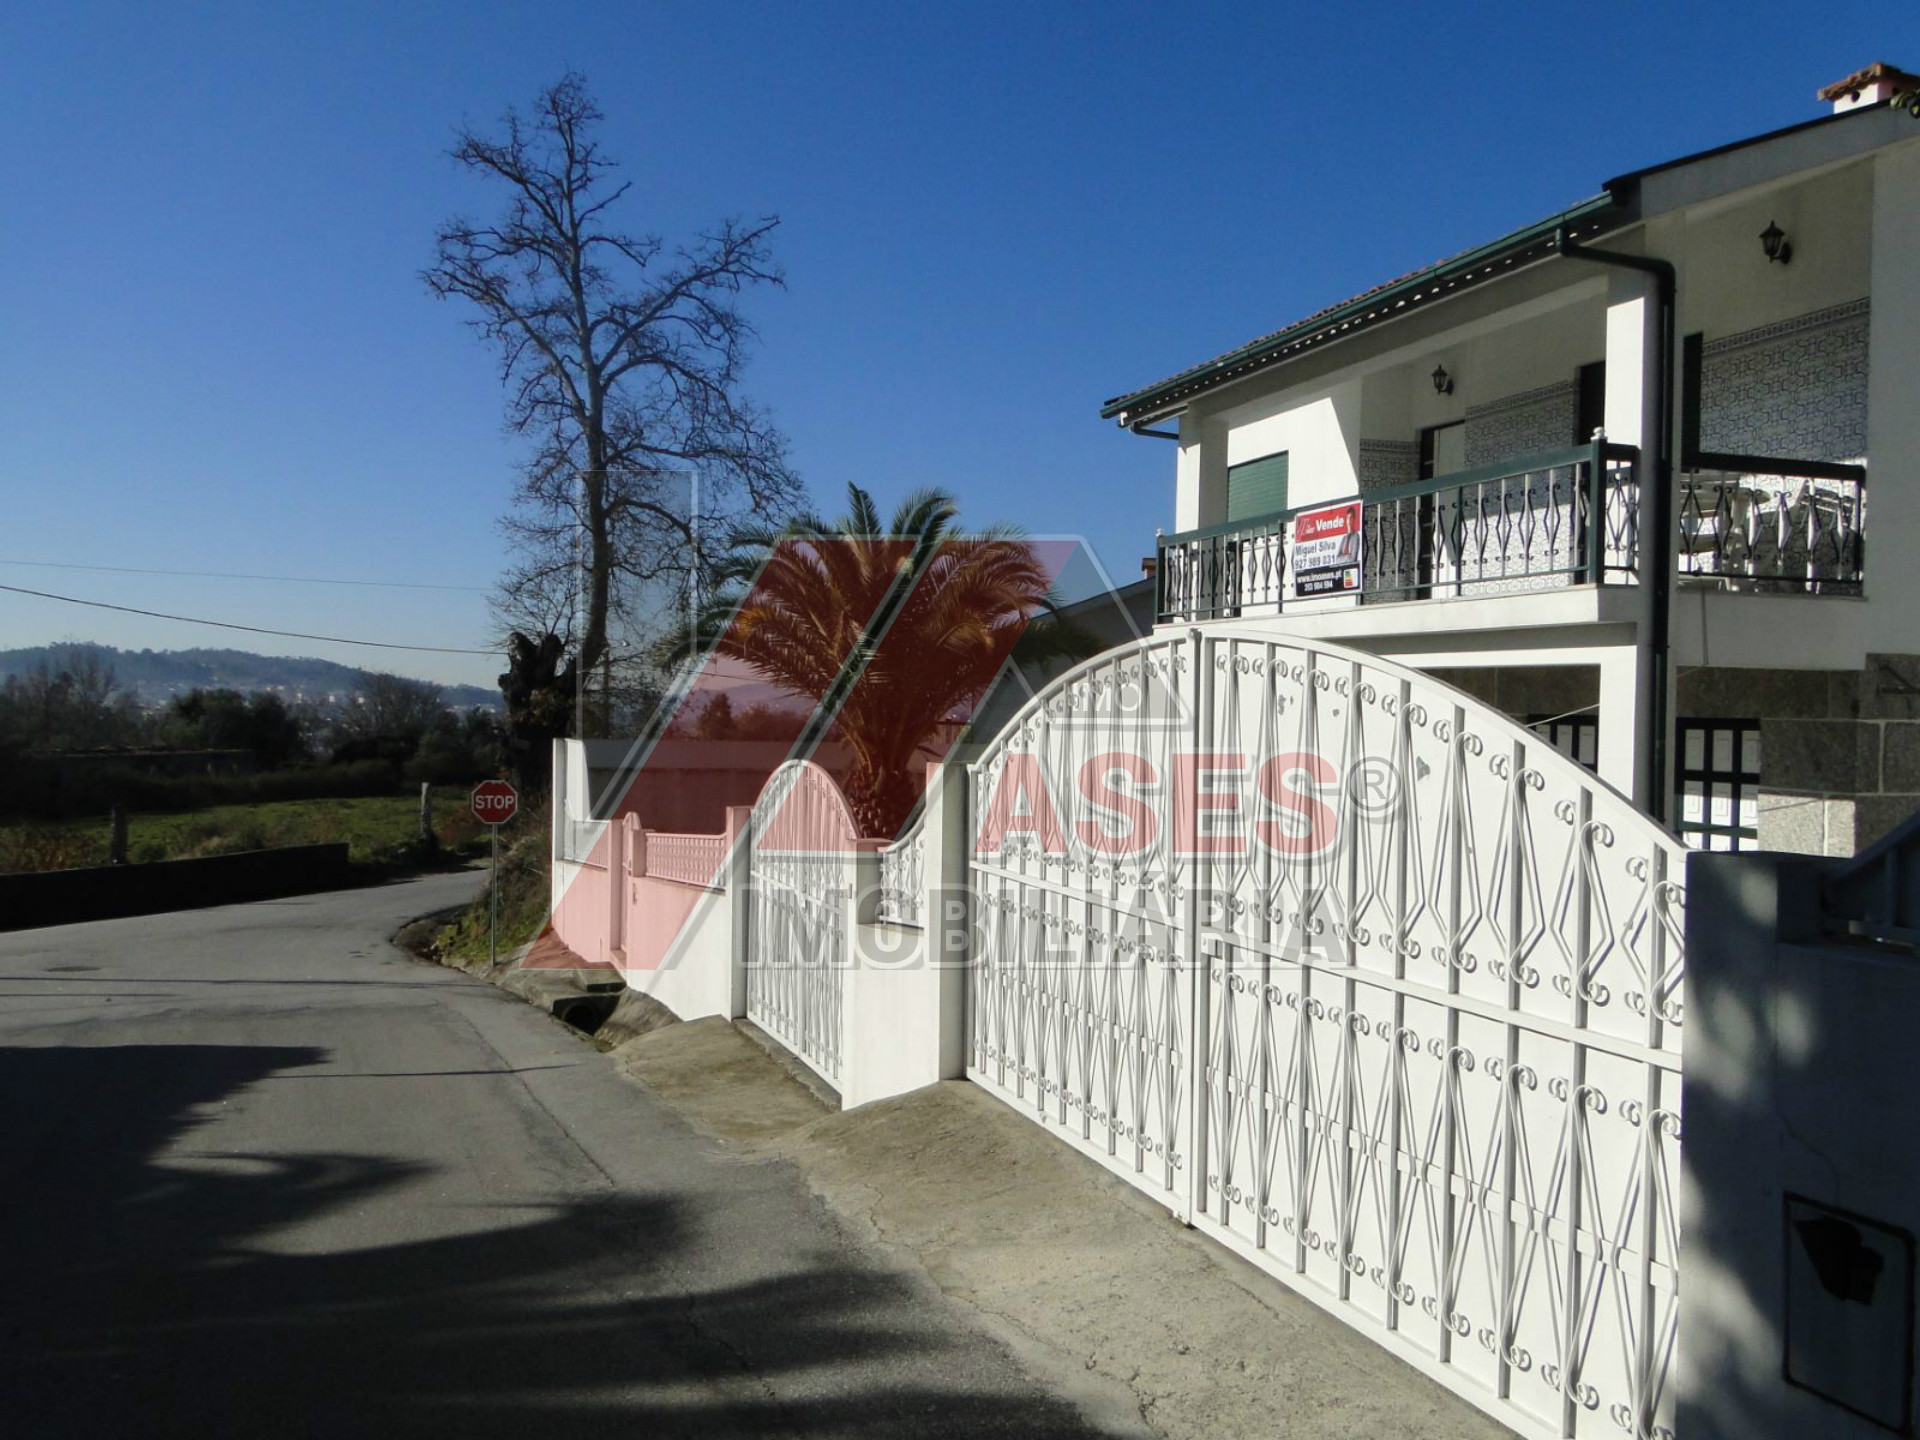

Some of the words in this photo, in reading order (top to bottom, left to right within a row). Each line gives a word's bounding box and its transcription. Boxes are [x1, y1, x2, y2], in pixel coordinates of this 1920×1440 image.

[1316, 516, 1344, 531] Vende
[1296, 542, 1317, 557] Miguel
[1319, 541, 1336, 552] Silva
[1295, 557, 1307, 569] 927
[475, 795, 515, 810] STOP
